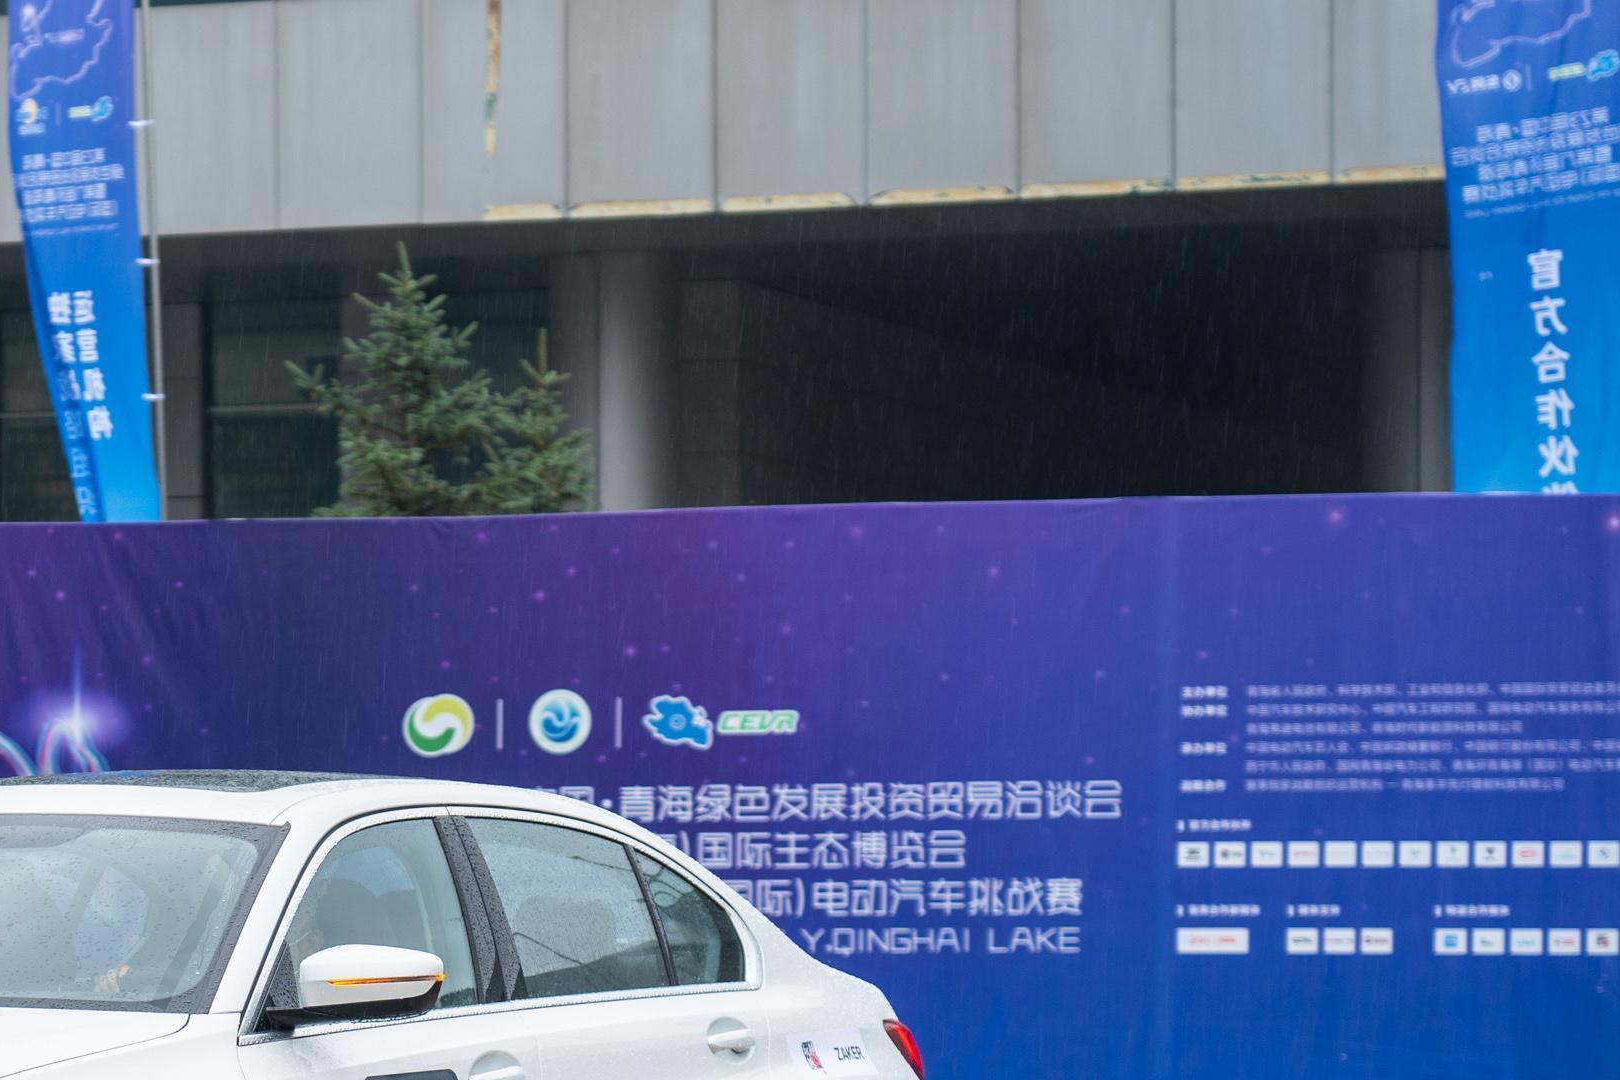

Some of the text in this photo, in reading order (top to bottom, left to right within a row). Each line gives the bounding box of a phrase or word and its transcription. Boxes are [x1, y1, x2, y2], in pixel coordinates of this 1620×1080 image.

[719, 711, 799, 733] CEVR
[533, 780, 1123, 822] ·青海绿色发展投资贸易洽谈会
[656, 830, 967, 870] )国际生态博览会
[988, 926, 1081, 955] LAKE
[834, 1046, 865, 1061] ZAKER
